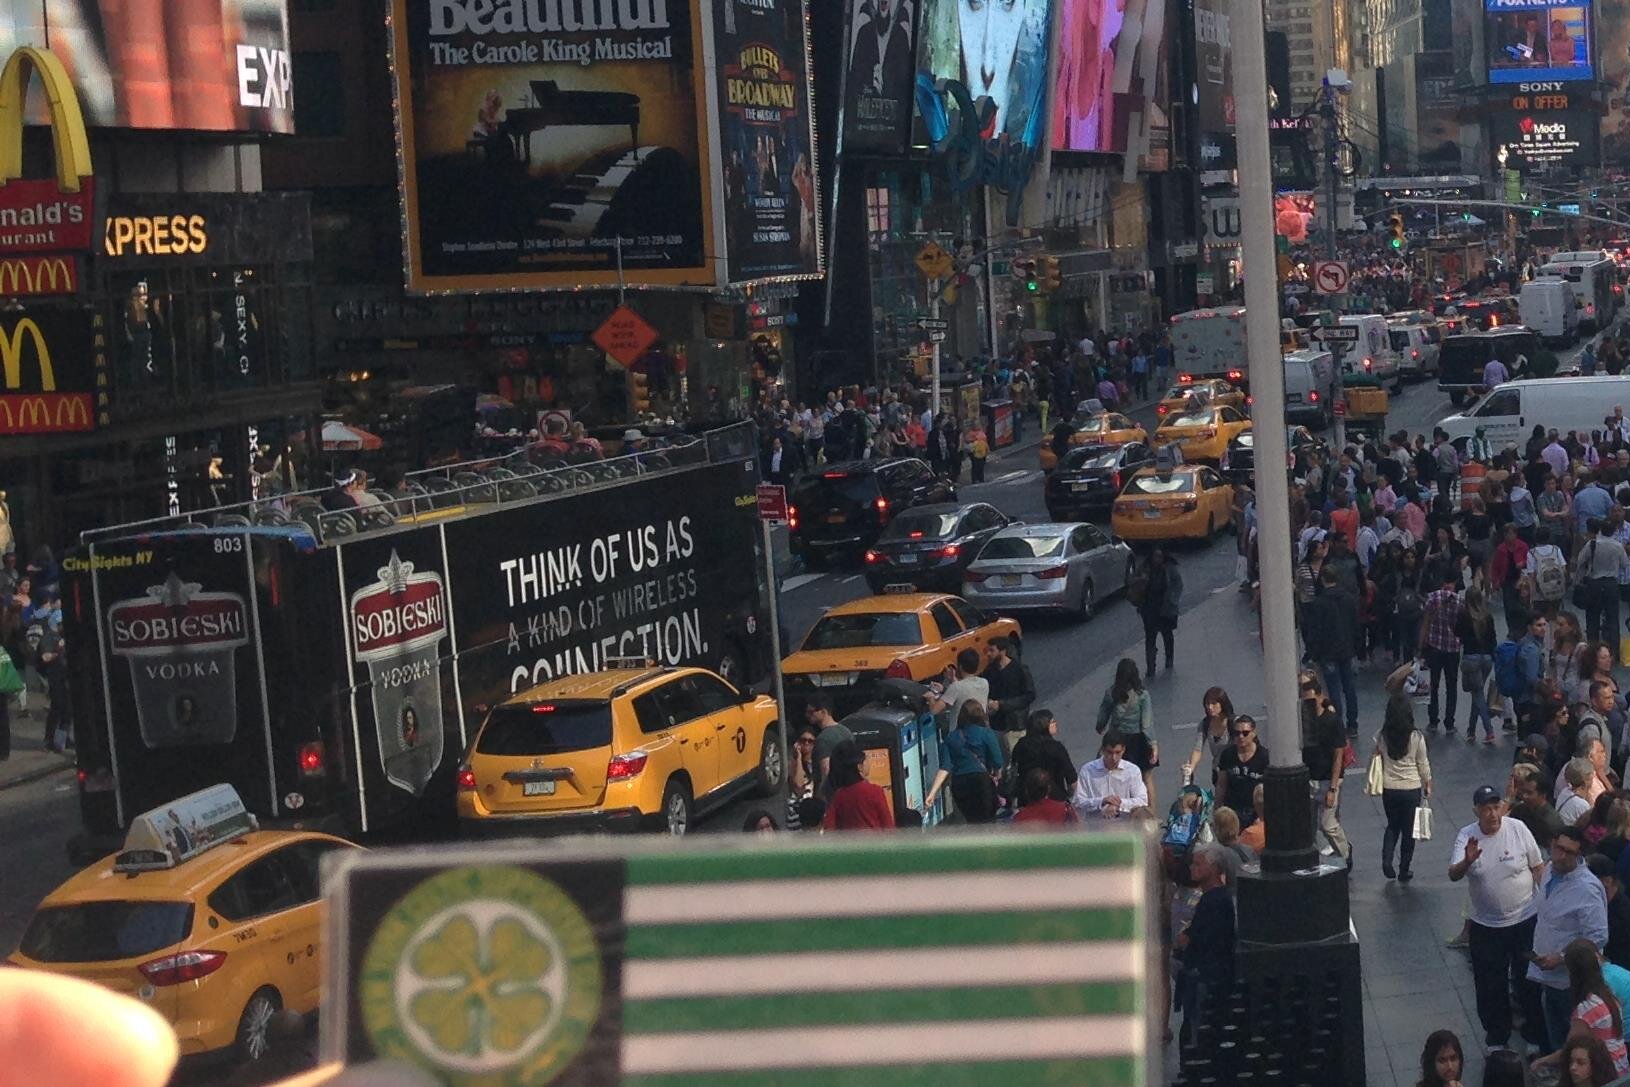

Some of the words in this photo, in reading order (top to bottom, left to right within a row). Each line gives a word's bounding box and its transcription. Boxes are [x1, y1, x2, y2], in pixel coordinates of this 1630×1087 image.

[430, 41, 469, 64] The
[472, 39, 538, 64] Carole
[540, 38, 591, 66] King
[595, 36, 672, 60] Musical
[740, 47, 779, 74] BULLETS
[728, 79, 794, 108] BROADWAY
[1520, 82, 1564, 92] SONY
[1536, 95, 1568, 109] OFFER
[0, 202, 83, 226] nald's
[0, 230, 55, 246] urant
[136, 550, 154, 565] NY
[214, 537, 242, 554] 803
[500, 544, 583, 607] THINK
[591, 534, 620, 583] OF
[627, 525, 659, 572] US
[666, 516, 694, 563] AS
[356, 594, 442, 644] SOBIESKI
[507, 622, 520, 655] A
[527, 605, 572, 647] KIND
[578, 595, 605, 630] OF
[612, 569, 697, 620] WIRELESS
[114, 610, 241, 643] SOBIESKI
[146, 661, 220, 680] VODKA
[381, 659, 431, 690] VODKA
